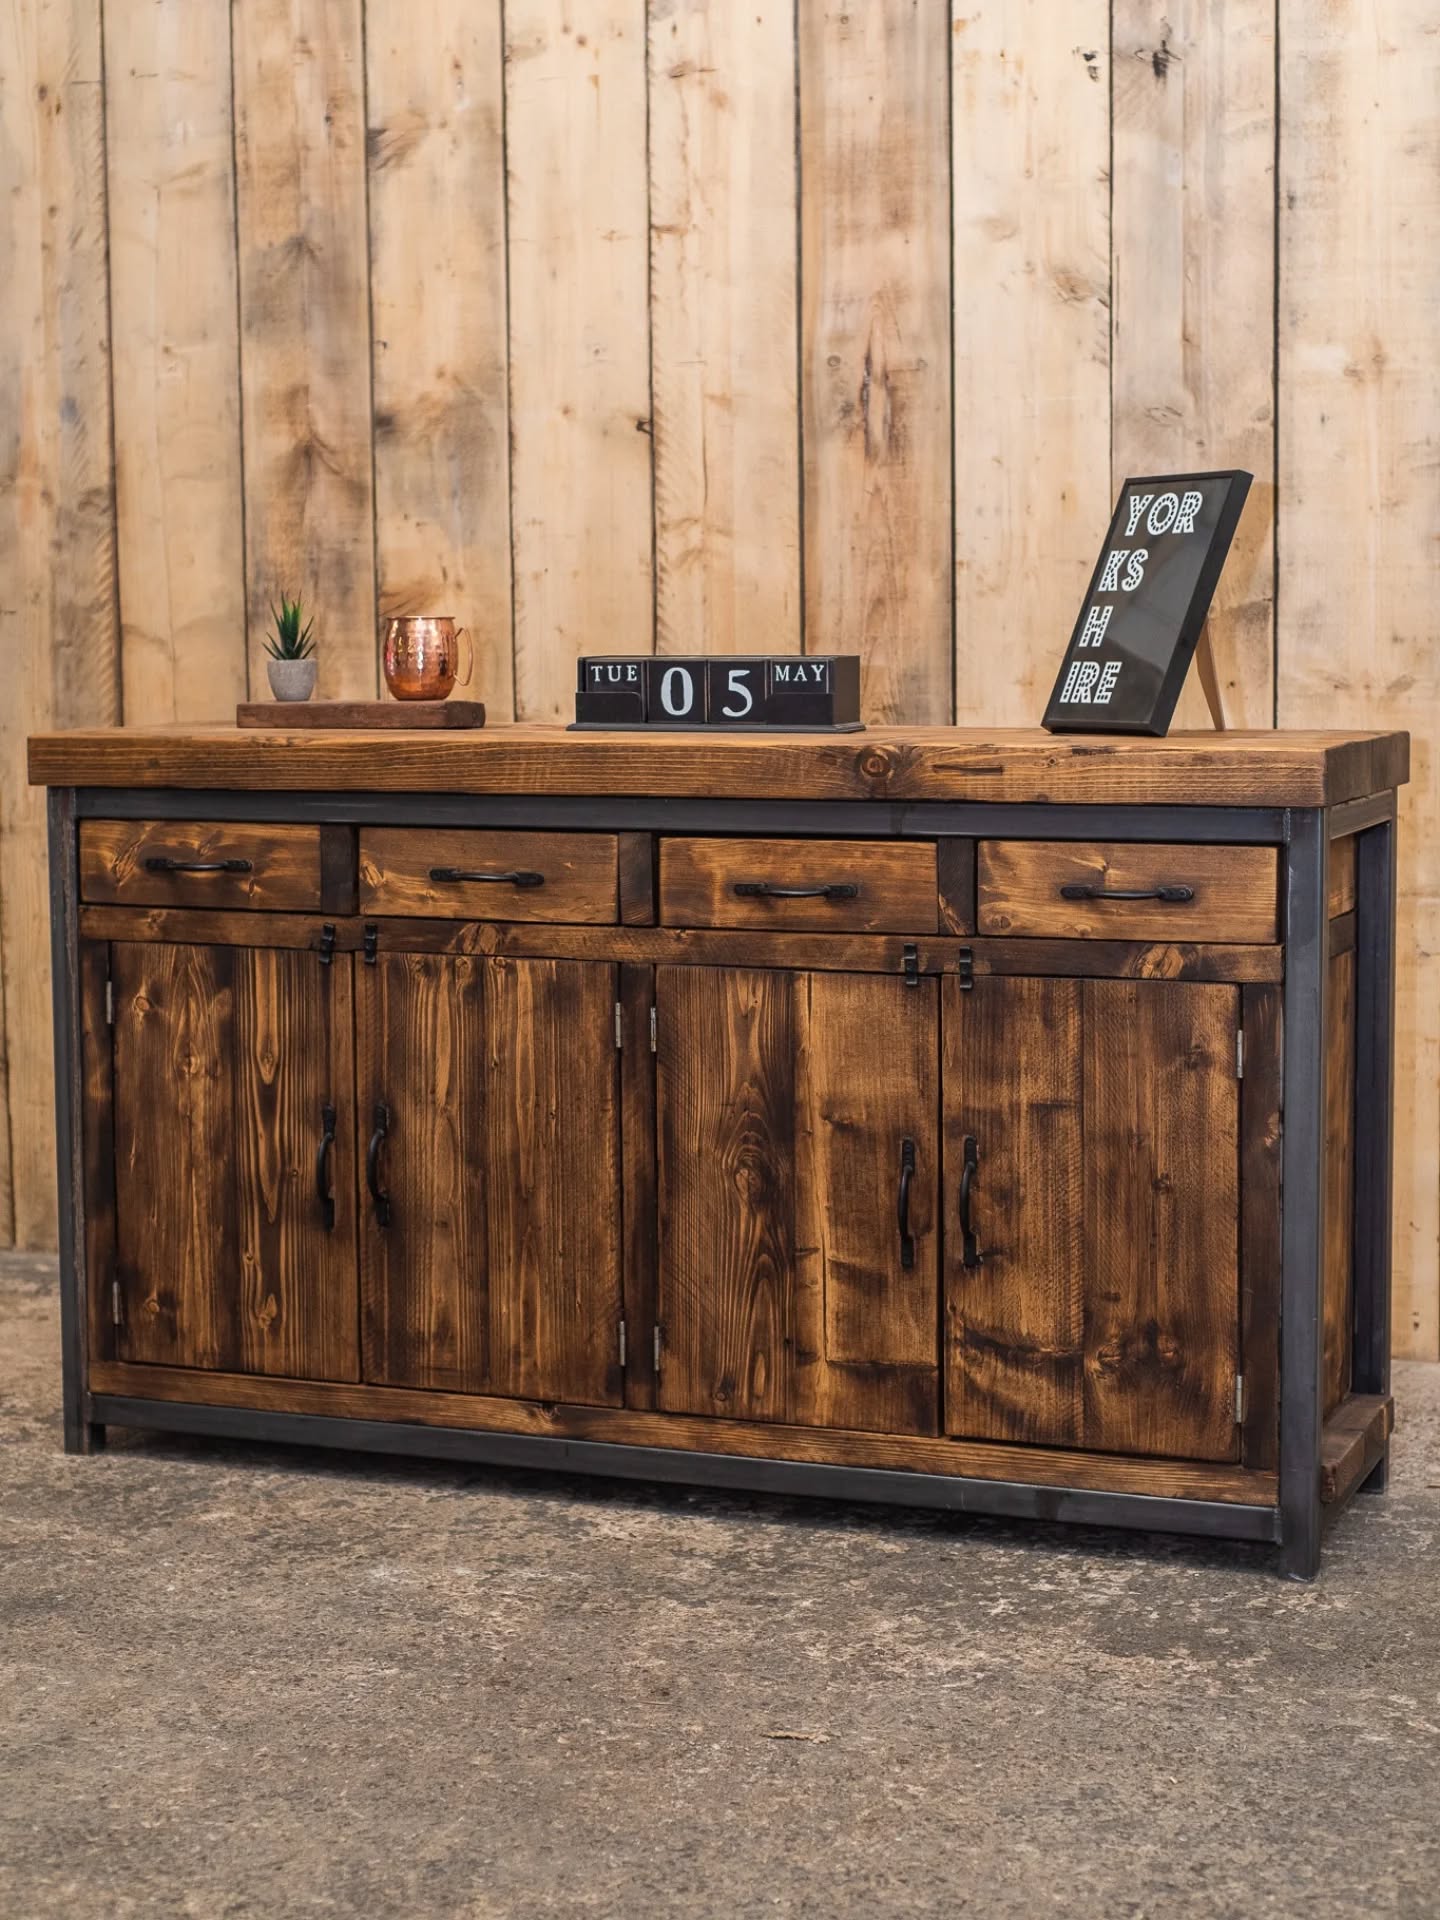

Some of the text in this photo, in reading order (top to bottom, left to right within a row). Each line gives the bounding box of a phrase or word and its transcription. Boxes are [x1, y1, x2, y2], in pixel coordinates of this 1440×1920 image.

[1124, 491, 1203, 536] YOR
[1097, 548, 1149, 592] KS
[1078, 605, 1114, 647] H
[590, 664, 638, 682] TUE
[774, 664, 825, 682] MAY
[1059, 661, 1123, 704] IRE
